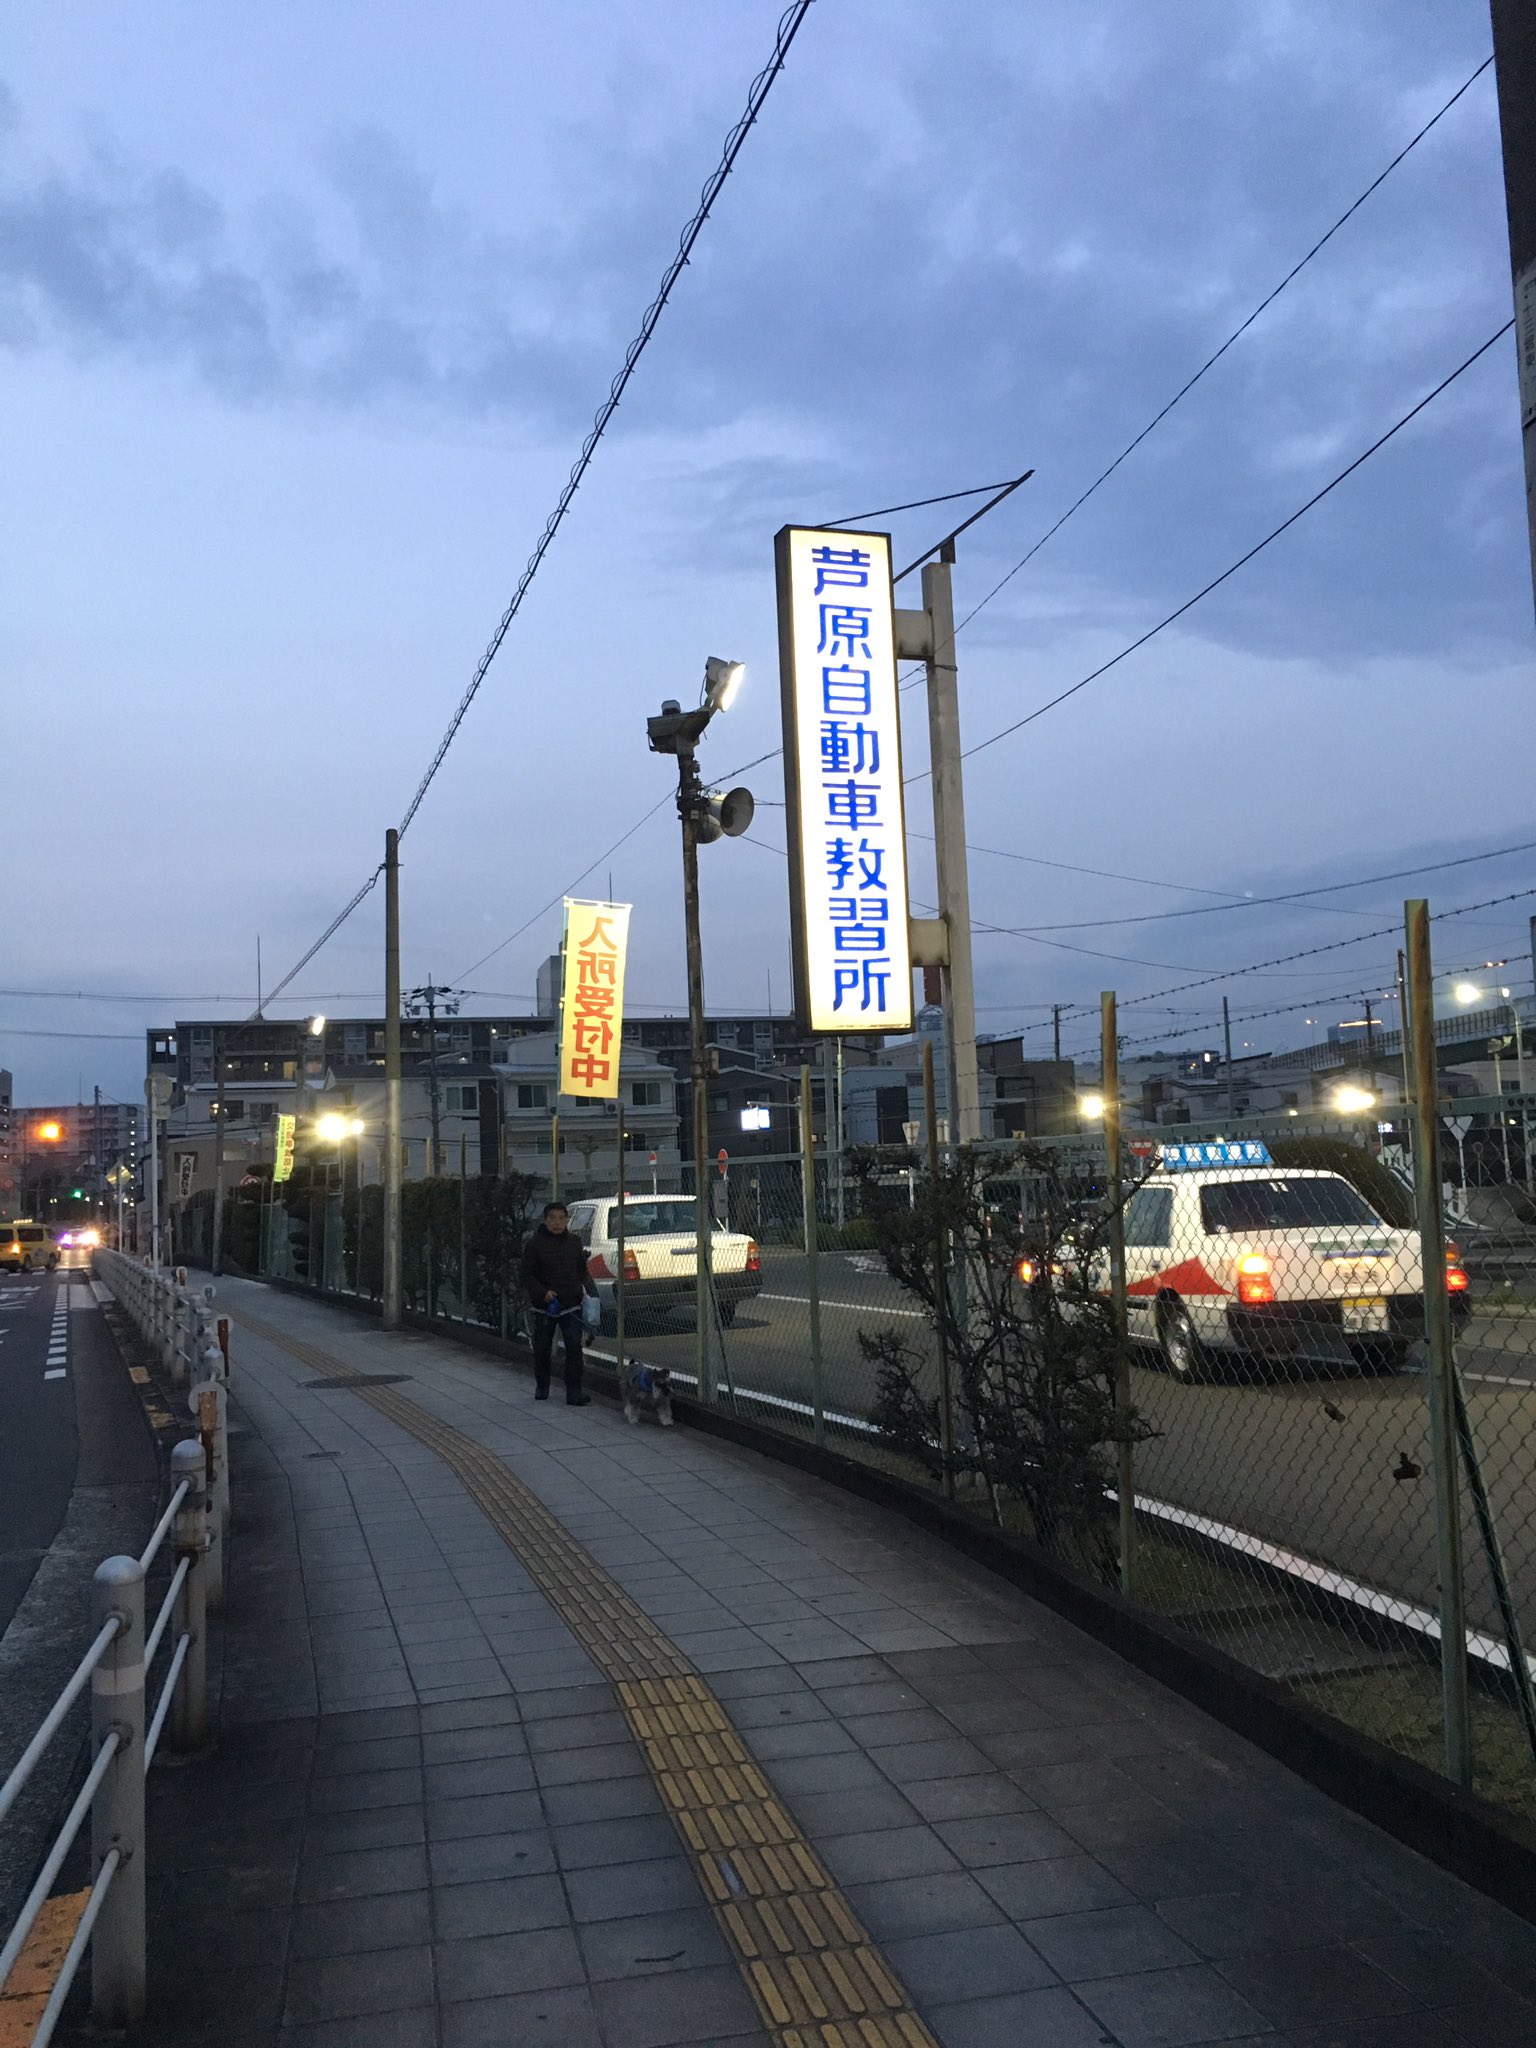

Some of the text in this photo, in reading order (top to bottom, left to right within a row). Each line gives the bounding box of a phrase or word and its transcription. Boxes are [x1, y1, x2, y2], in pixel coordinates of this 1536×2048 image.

[812, 547, 891, 1012] 芦原自動車教習所
